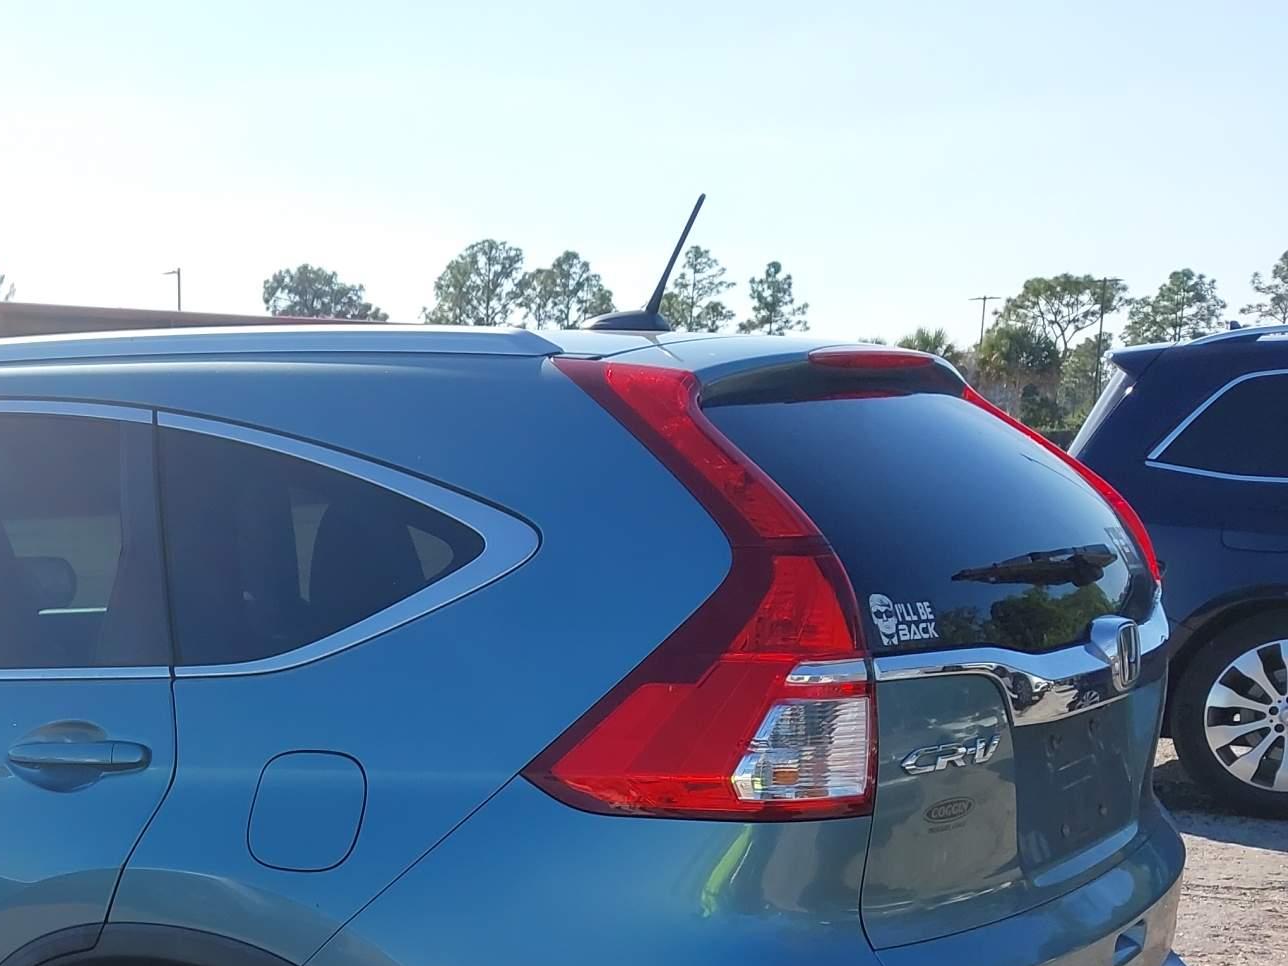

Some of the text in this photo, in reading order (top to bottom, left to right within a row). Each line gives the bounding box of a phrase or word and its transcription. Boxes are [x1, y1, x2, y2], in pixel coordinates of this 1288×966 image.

[894, 601, 934, 621] I'LL BE
[898, 622, 939, 640] BACK
[901, 735, 1000, 775] CR-V
